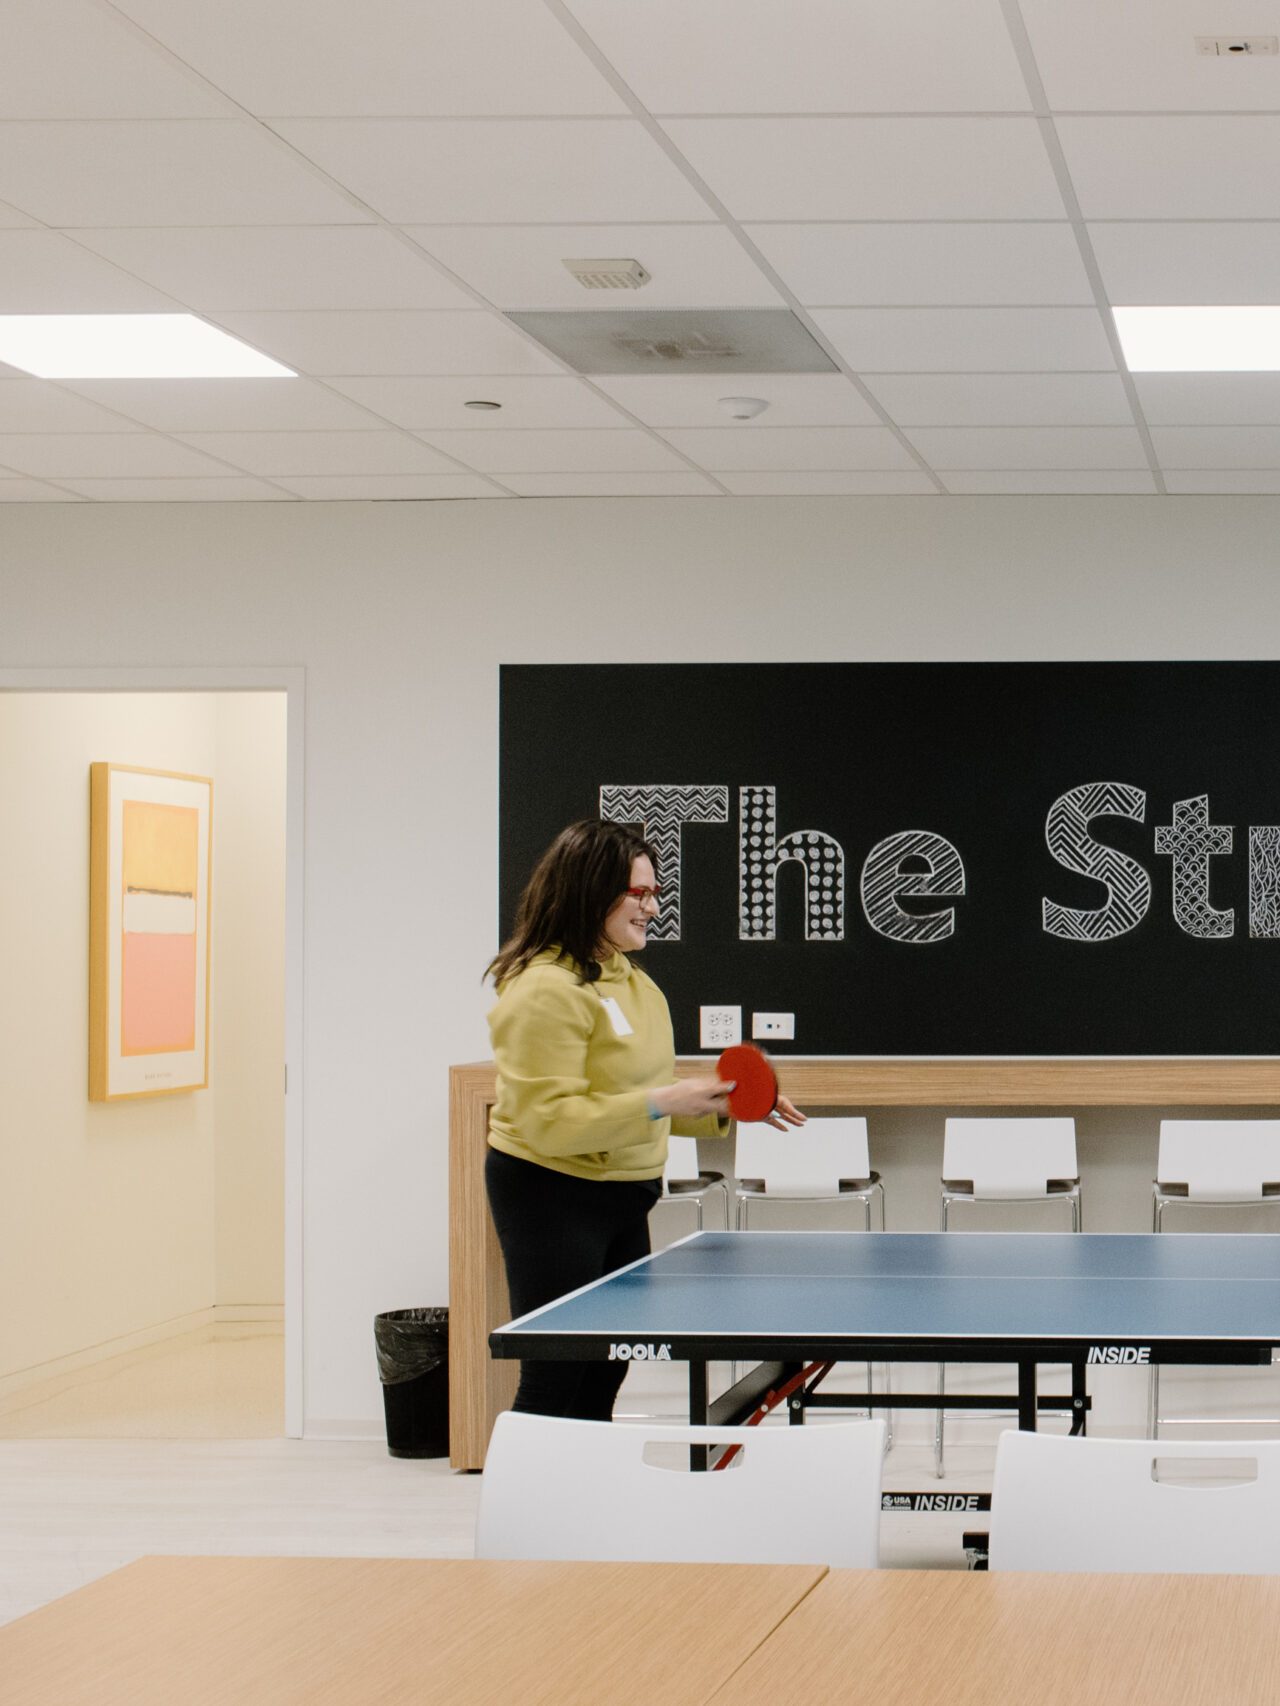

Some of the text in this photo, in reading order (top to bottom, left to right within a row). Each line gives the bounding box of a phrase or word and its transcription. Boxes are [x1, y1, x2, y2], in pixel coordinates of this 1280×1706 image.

[599, 784, 966, 943] The
[608, 1343, 672, 1360] JOOLA
[1087, 1346, 1151, 1364] INSIDE
[914, 1495, 979, 1511] INSIDE
